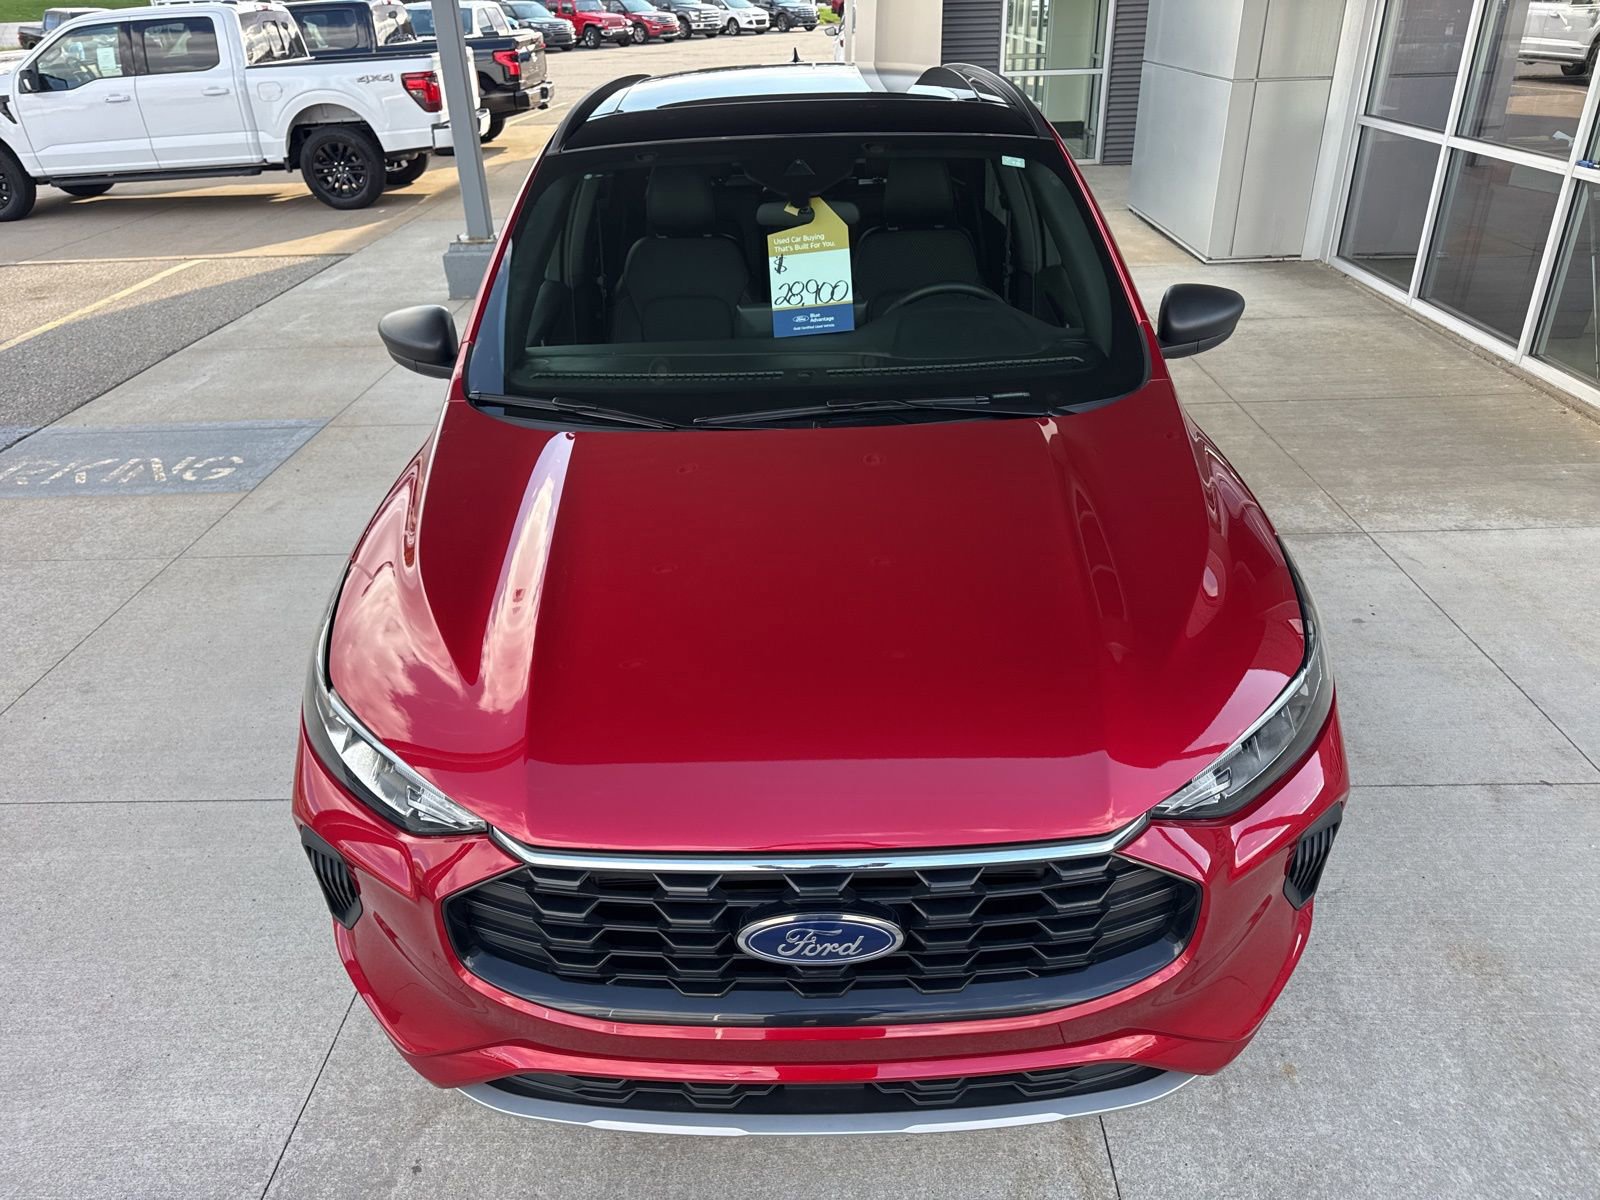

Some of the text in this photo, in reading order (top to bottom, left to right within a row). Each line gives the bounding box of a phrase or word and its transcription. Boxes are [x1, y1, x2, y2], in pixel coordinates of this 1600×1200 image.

[773, 237, 790, 245] Used
[802, 233, 825, 242] Buying
[774, 245, 793, 253] That's
[794, 242, 809, 251] Built
[810, 241, 821, 249] For
[774, 254, 787, 274] $
[774, 279, 849, 307] 28,900
[777, 928, 865, 957] Ford
